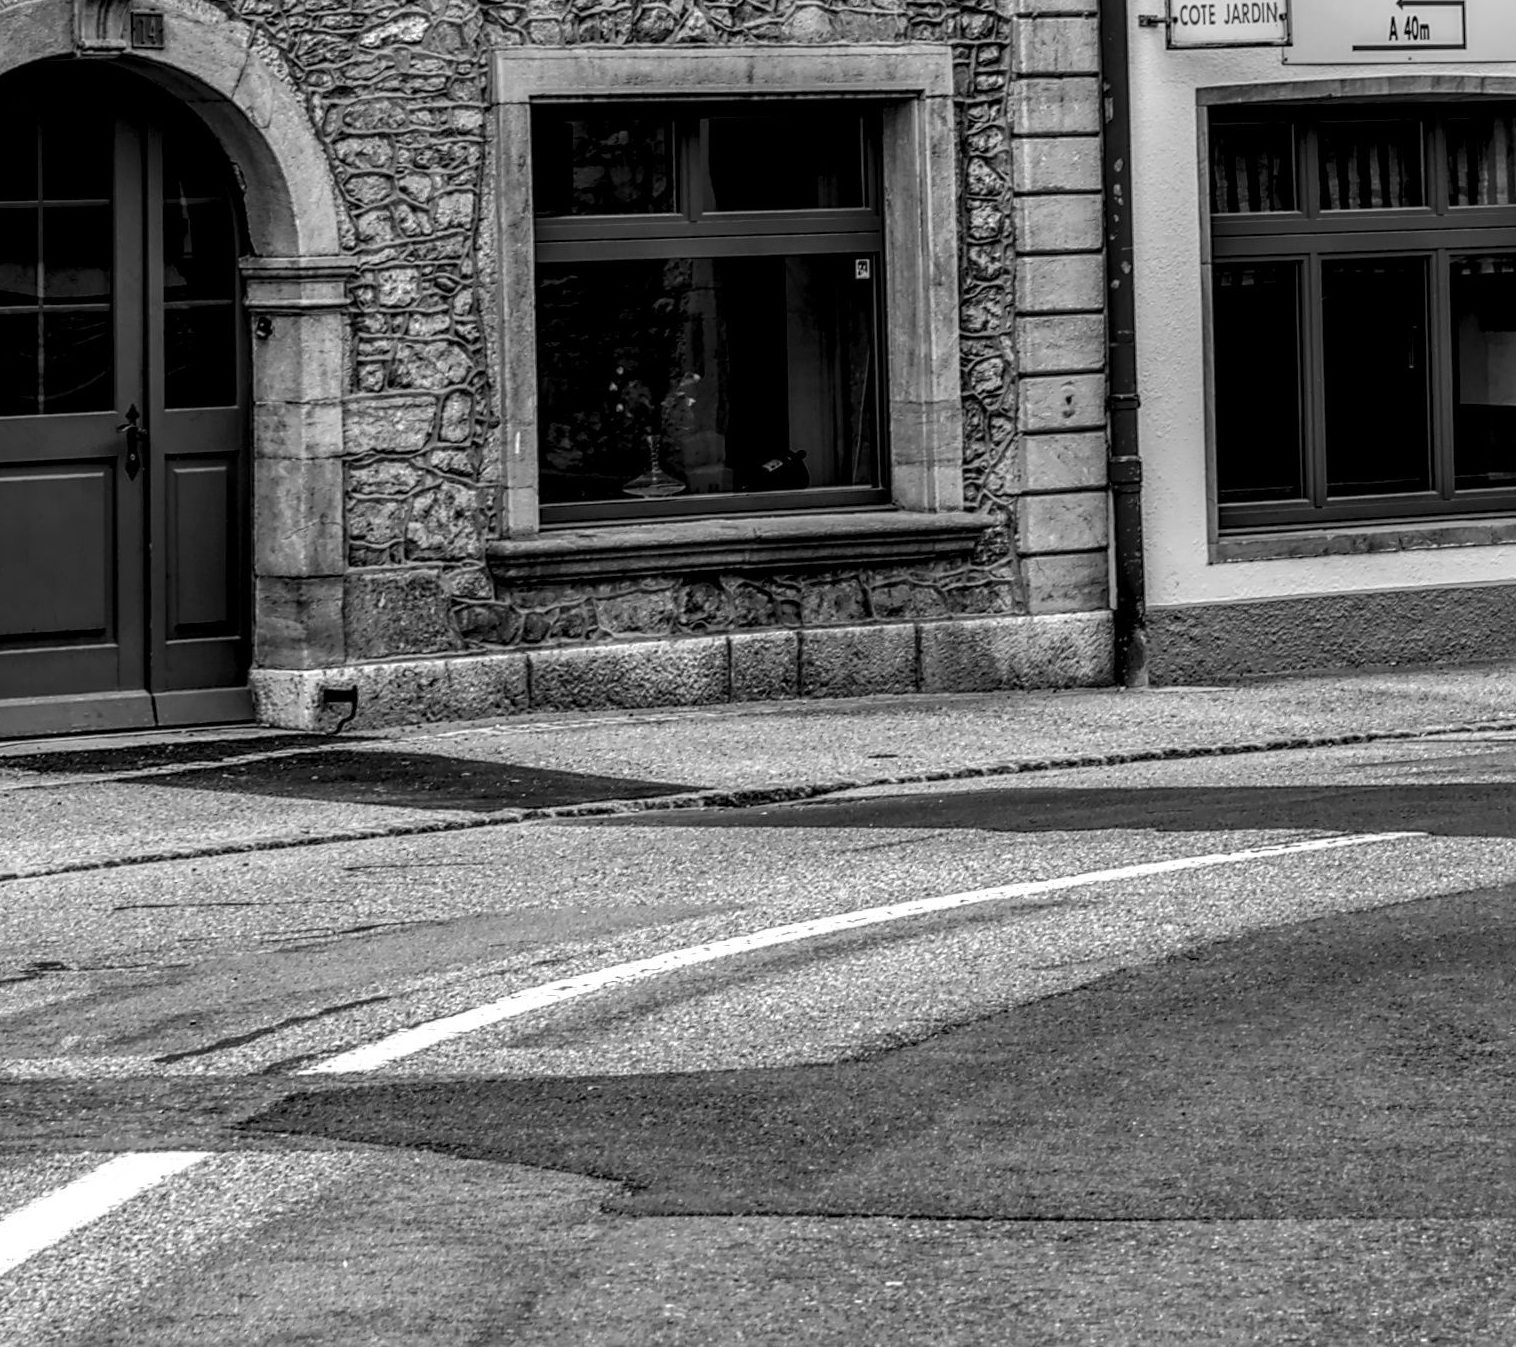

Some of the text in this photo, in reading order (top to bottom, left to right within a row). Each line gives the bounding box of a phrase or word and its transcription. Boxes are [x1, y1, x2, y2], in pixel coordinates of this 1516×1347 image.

[1180, 2, 1278, 26] COTE JARDIN
[1388, 15, 1430, 41] A 40m
